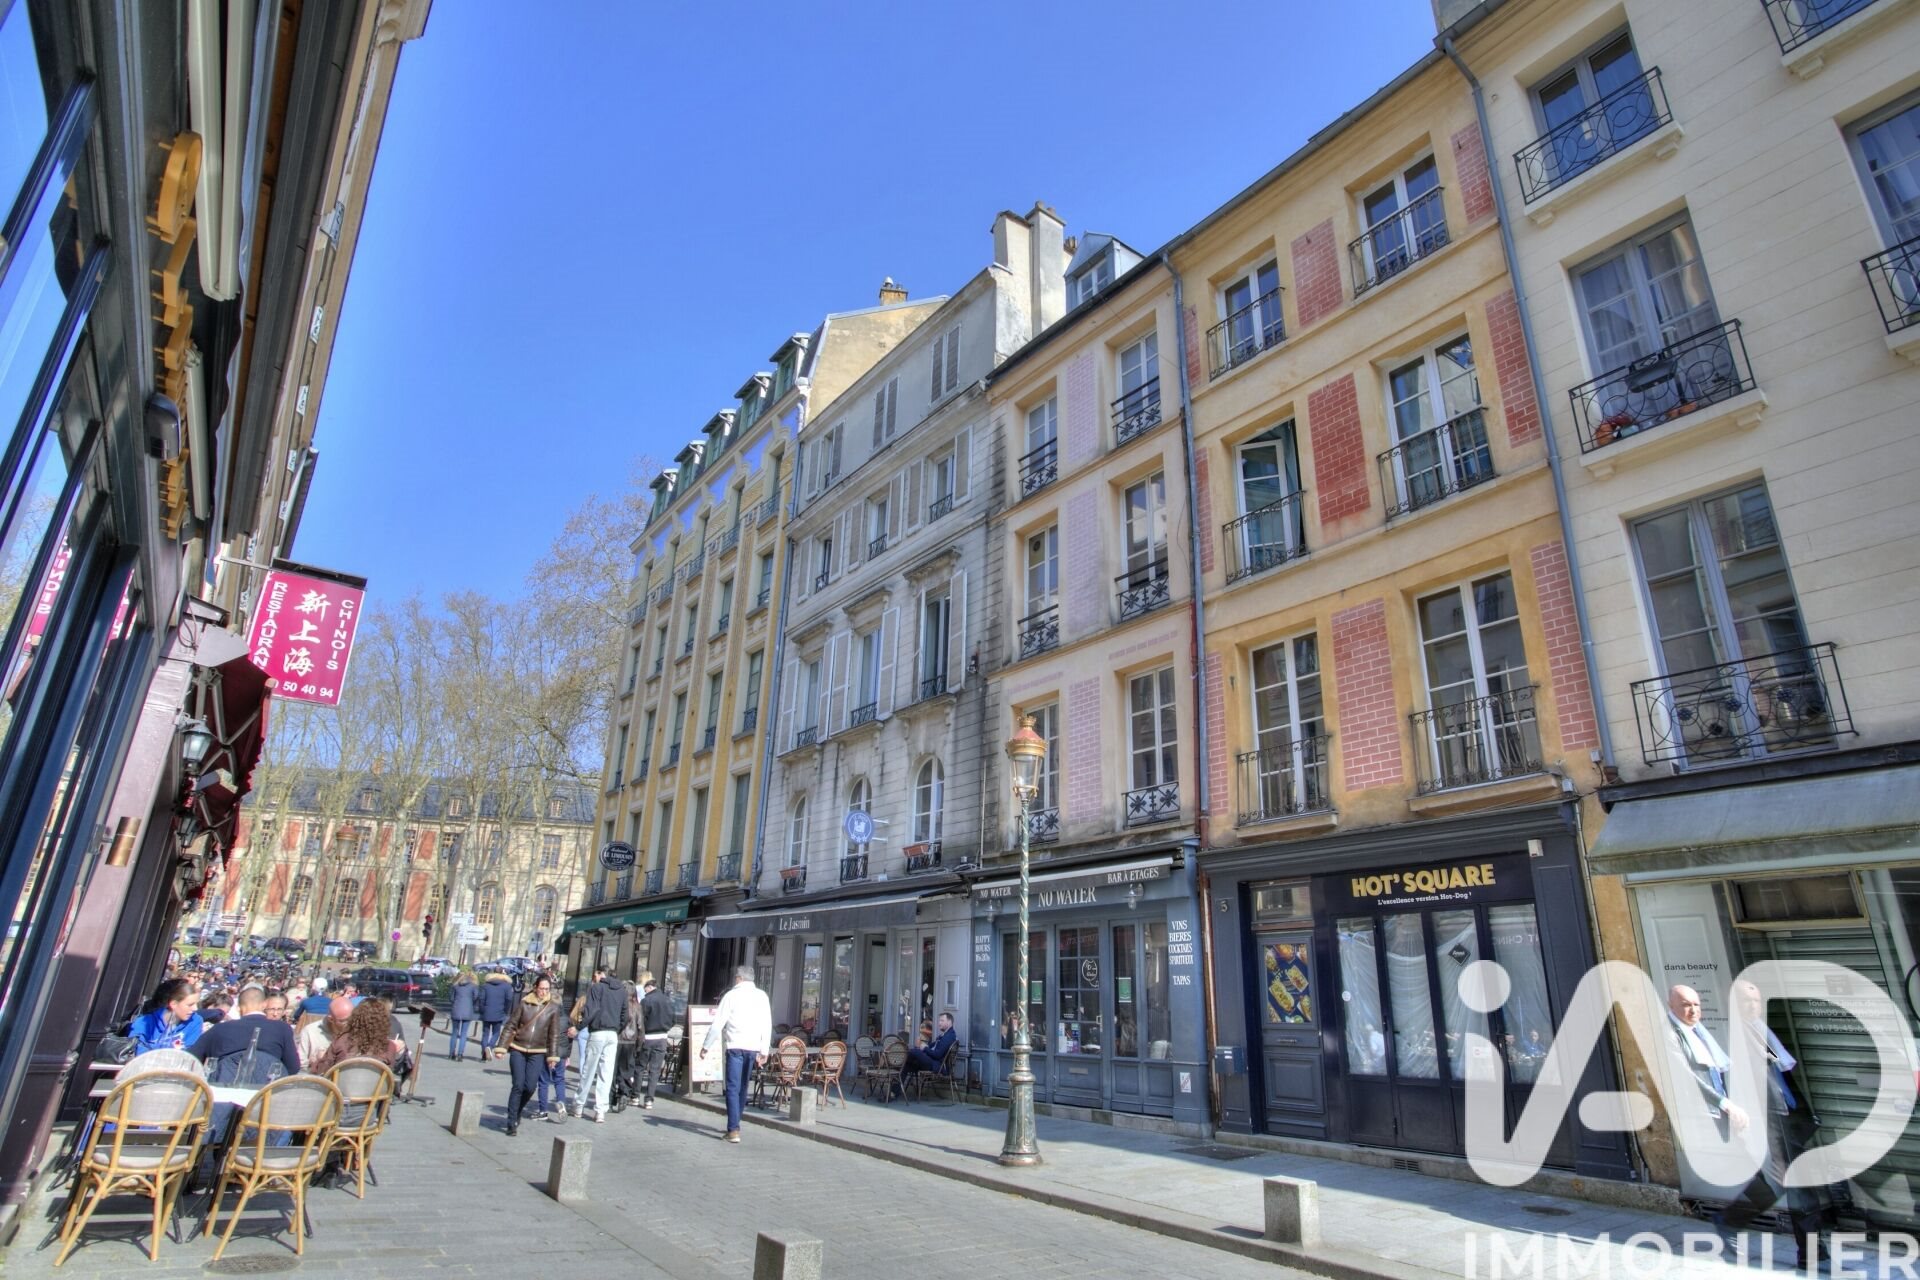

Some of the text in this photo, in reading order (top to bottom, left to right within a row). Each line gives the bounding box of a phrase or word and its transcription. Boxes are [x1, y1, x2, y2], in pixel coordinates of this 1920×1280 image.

[252, 581, 288, 670] RESTAURAN
[283, 589, 331, 677] 新上海
[326, 600, 354, 670] CHINOIS
[283, 681, 297, 692] 50
[301, 684, 315, 694] 40
[319, 687, 334, 698] 94
[1107, 872, 1123, 884] BAR
[1402, 863, 1496, 894] SQUARE
[980, 886, 1012, 898] NO WATER
[1038, 886, 1097, 907] NO WATER
[1415, 894, 1439, 902] version
[1220, 900, 1228, 913] 5
[780, 916, 810, 931] Le Jasmin
[1171, 920, 1188, 930] VINS
[975, 935, 990, 943] HAPPY
[975, 944, 991, 952] HOURS
[1664, 962, 1718, 972] dana beauty
[1172, 975, 1191, 985] TAPAS
